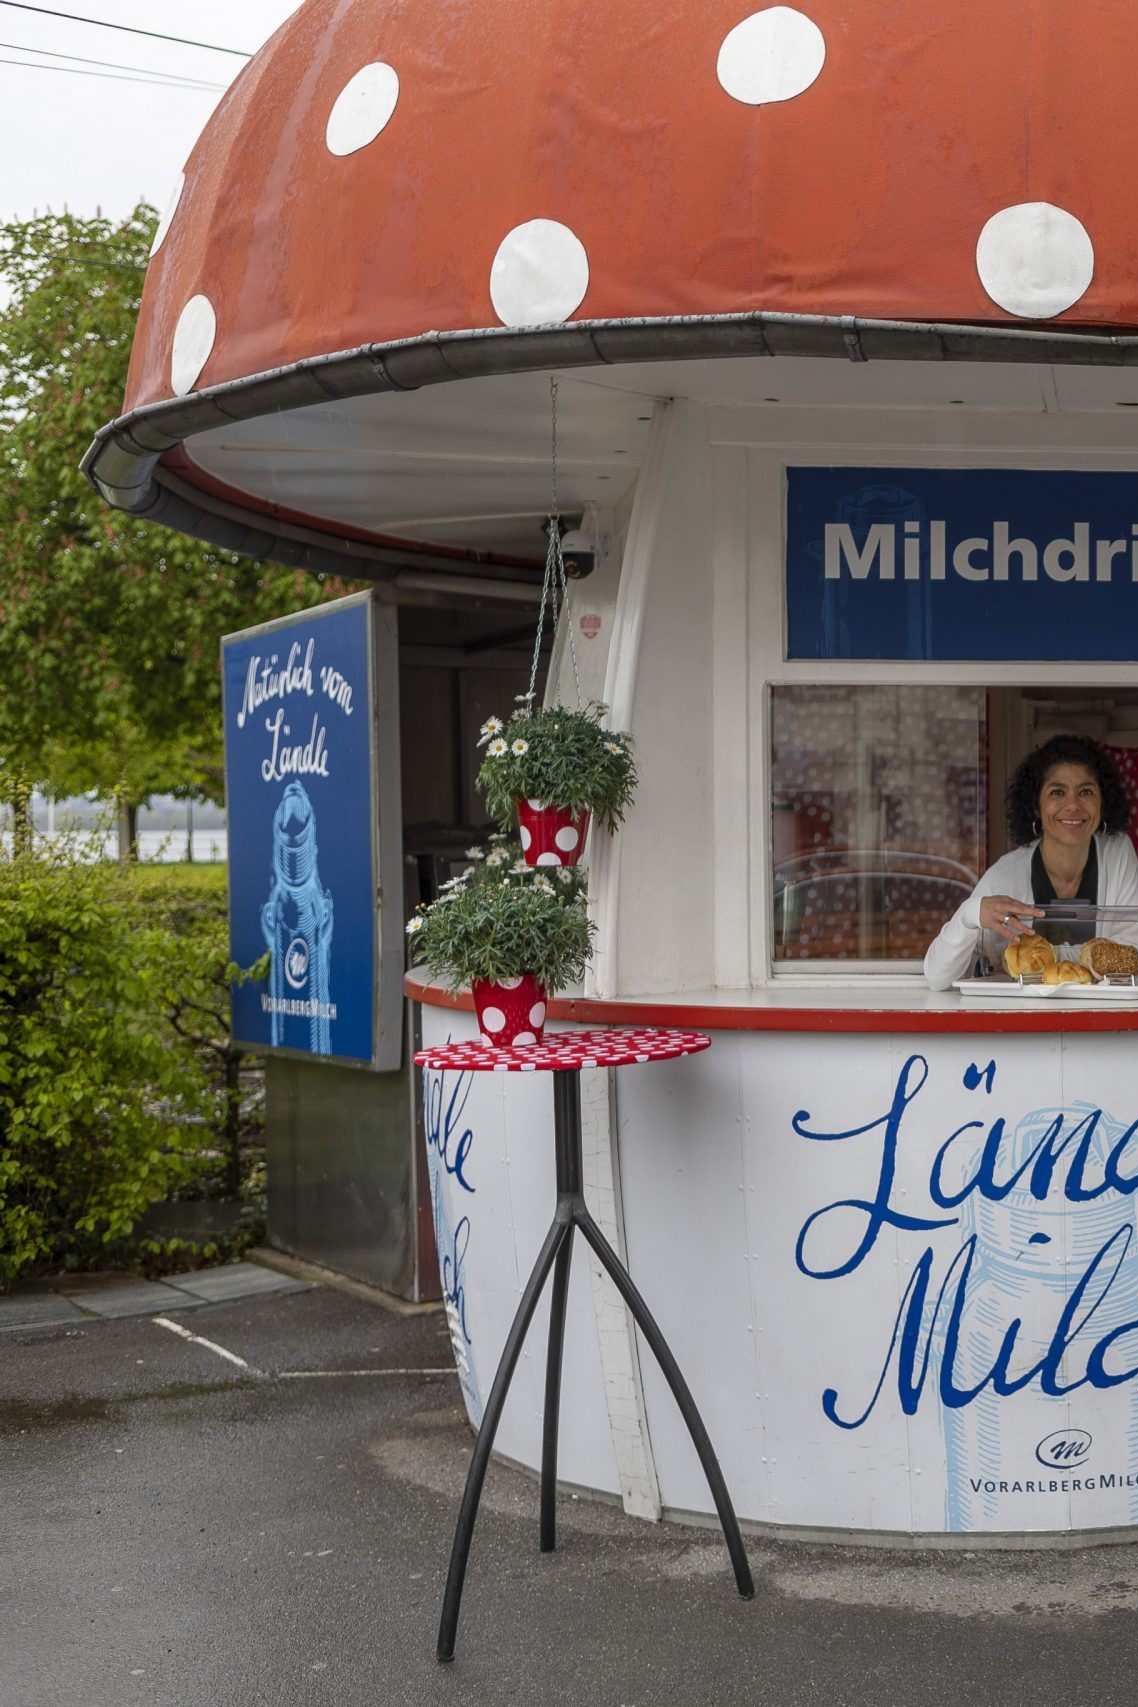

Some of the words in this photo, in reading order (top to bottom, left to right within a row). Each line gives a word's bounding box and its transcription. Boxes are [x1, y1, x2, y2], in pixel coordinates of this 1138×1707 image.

[236, 637, 315, 728] Natürlich
[320, 665, 353, 716] vom
[261, 708, 330, 782] Ländle
